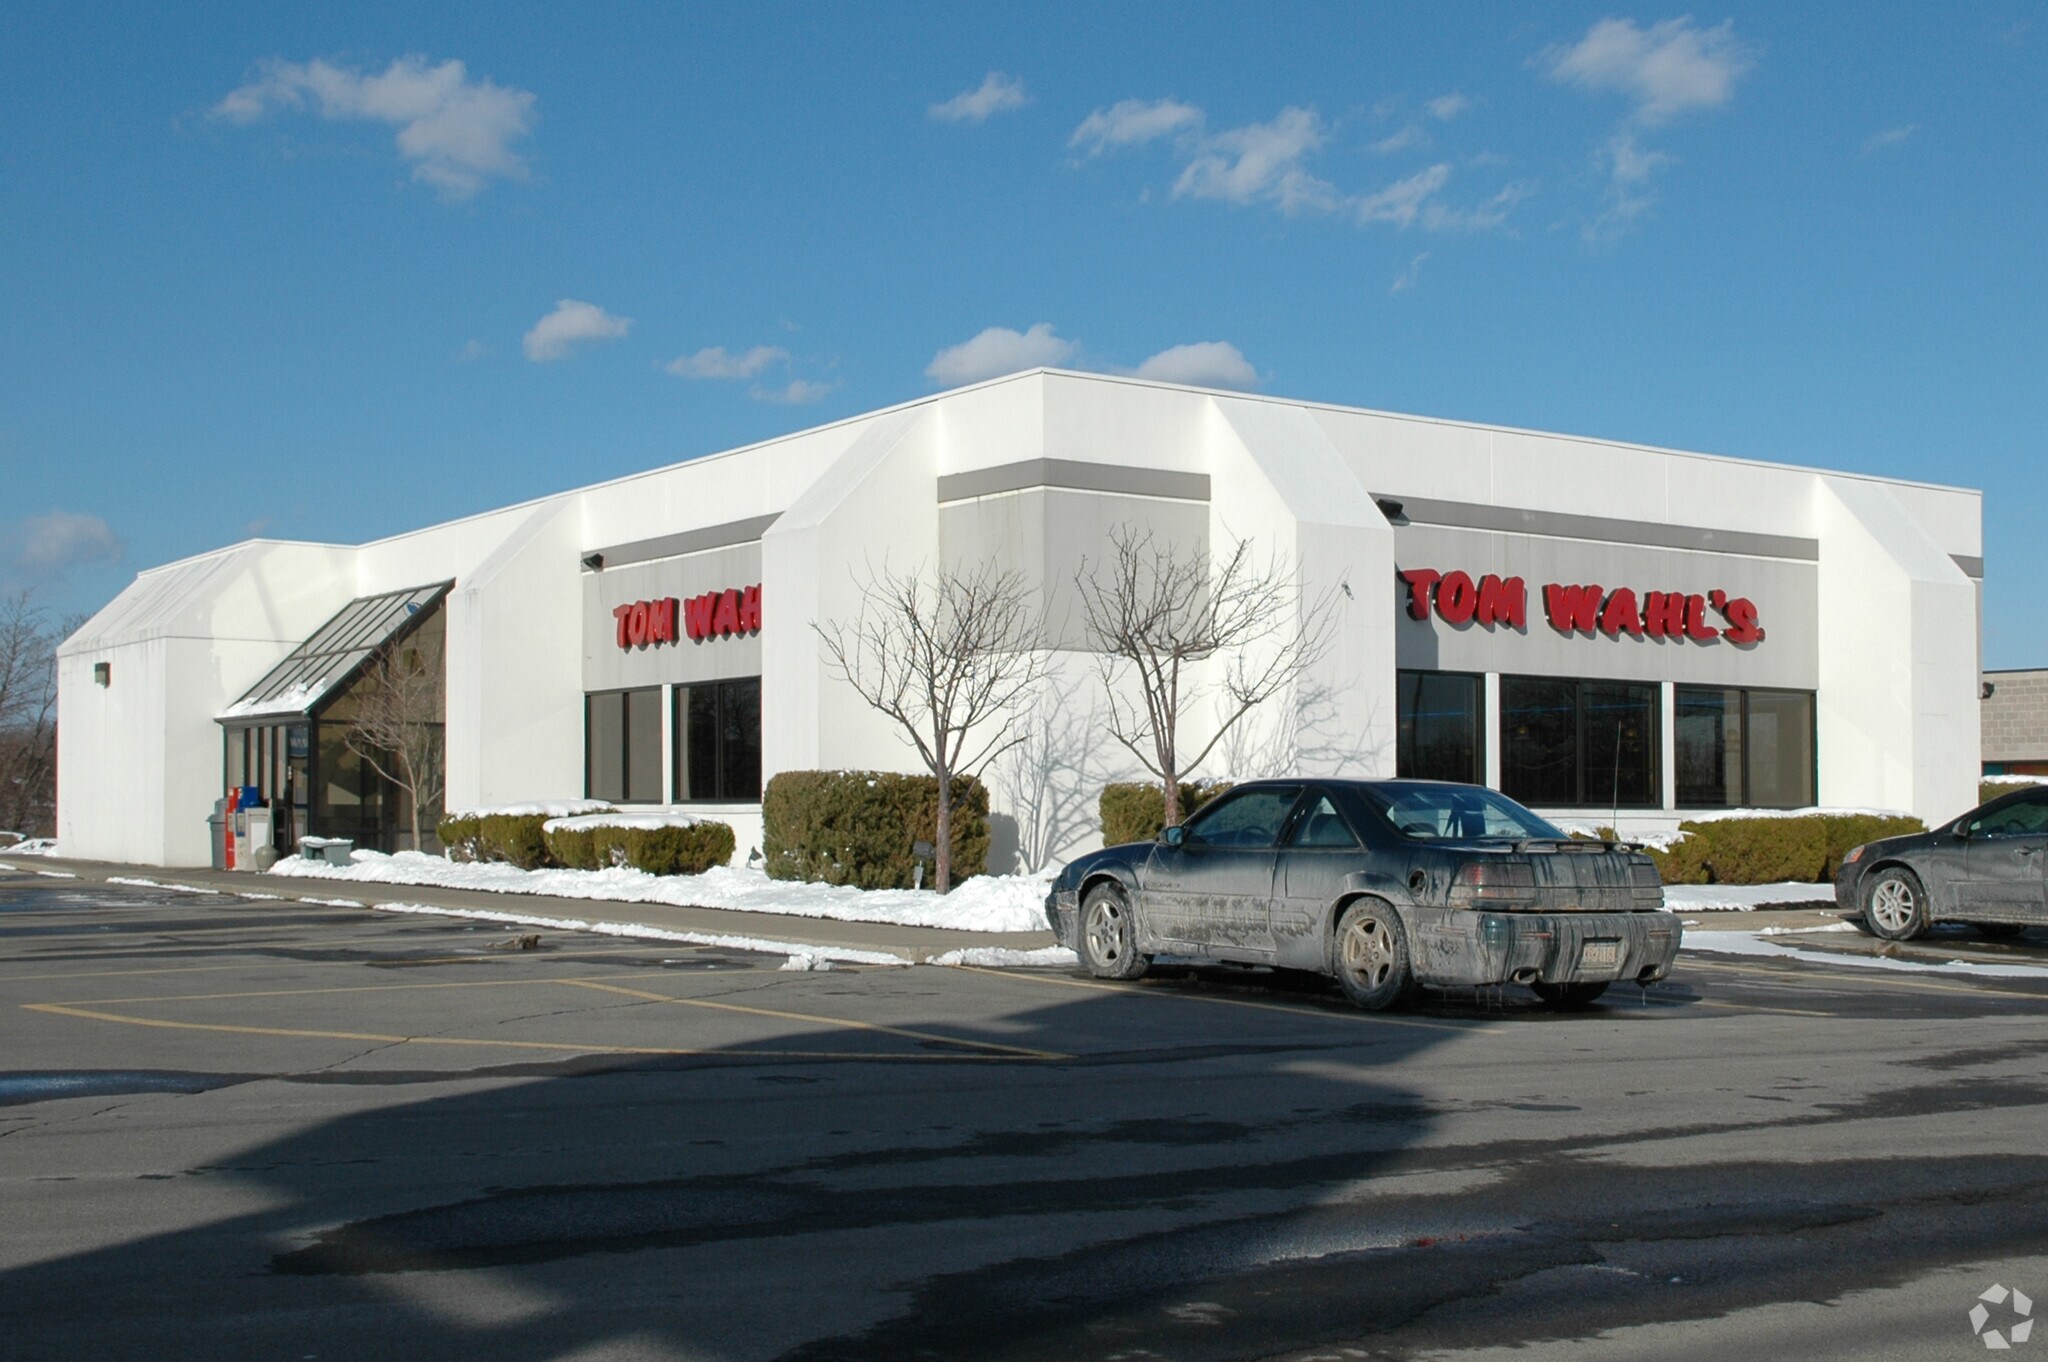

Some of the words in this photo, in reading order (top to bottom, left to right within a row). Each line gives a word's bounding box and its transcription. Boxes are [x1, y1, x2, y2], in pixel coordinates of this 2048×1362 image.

[613, 597, 676, 649] TOM
[1400, 568, 1526, 628] TOM
[1545, 583, 1765, 643] WAHL'S
